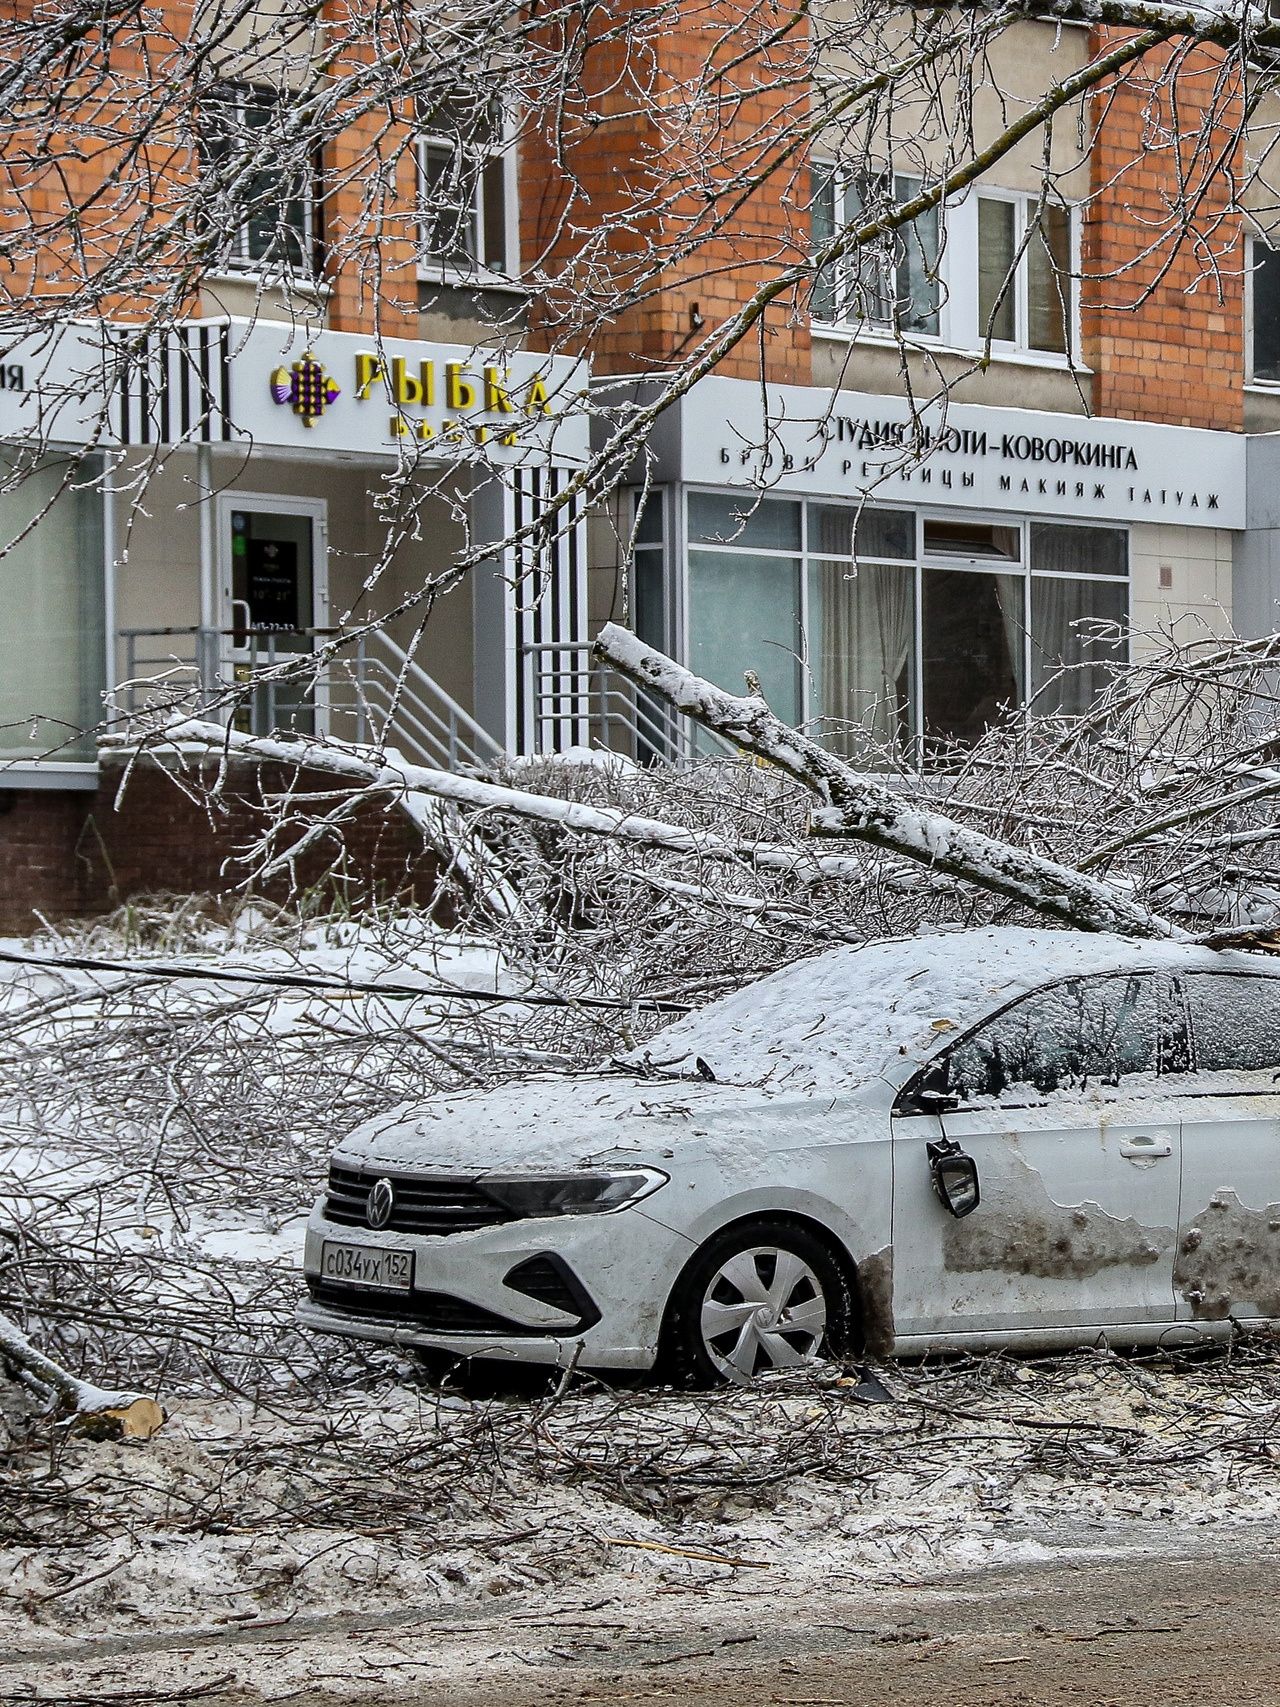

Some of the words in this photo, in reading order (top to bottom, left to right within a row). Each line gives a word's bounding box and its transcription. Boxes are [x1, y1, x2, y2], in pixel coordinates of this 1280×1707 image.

[356, 352, 551, 416] РЫБКА
[818, 415, 905, 451] СТУДИЯ
[720, 447, 815, 473] БРОВИ
[842, 459, 975, 489] РЕСНИЦЫ
[1000, 475, 1106, 499] МАКИЯЖ
[1129, 486, 1220, 509] ТАТУАЖ
[384, 1253, 408, 1276] 152
